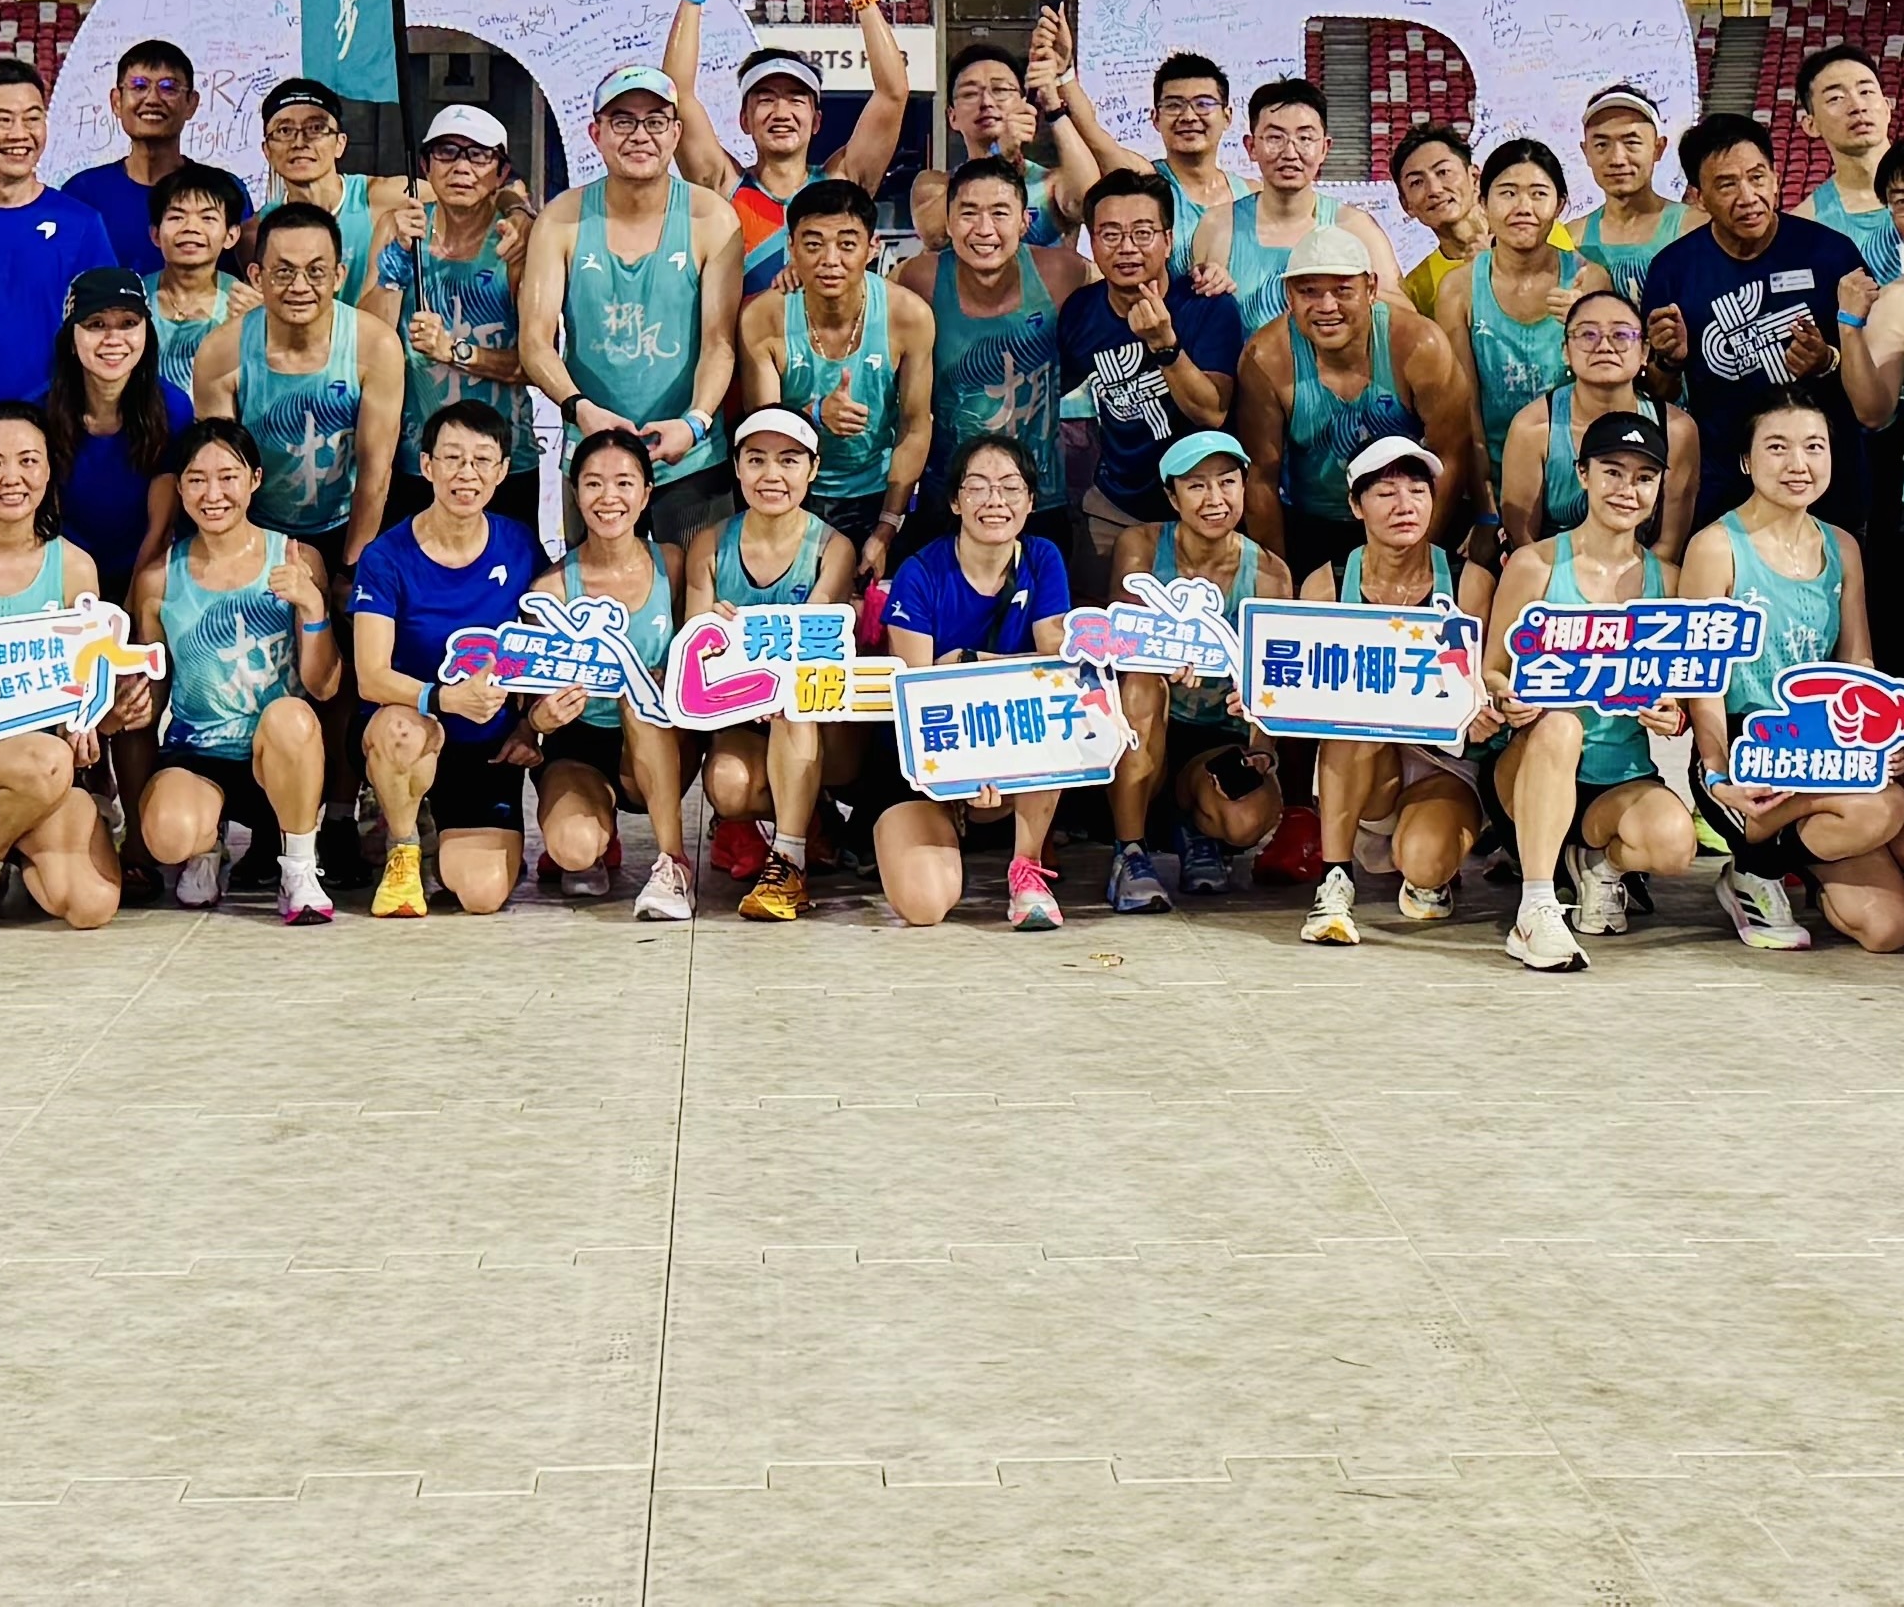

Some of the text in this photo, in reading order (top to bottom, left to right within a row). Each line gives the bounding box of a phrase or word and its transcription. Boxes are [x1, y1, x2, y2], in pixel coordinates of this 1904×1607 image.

[741, 613, 846, 663] 我要
[1541, 610, 1756, 653] 椰风之路!
[794, 664, 895, 713] 破三
[1261, 639, 1443, 697] 最帅椰子
[1519, 653, 1720, 699] 全力以赴!
[919, 693, 1088, 753] 最帅椰子
[1739, 744, 1877, 784] 挑战极限
